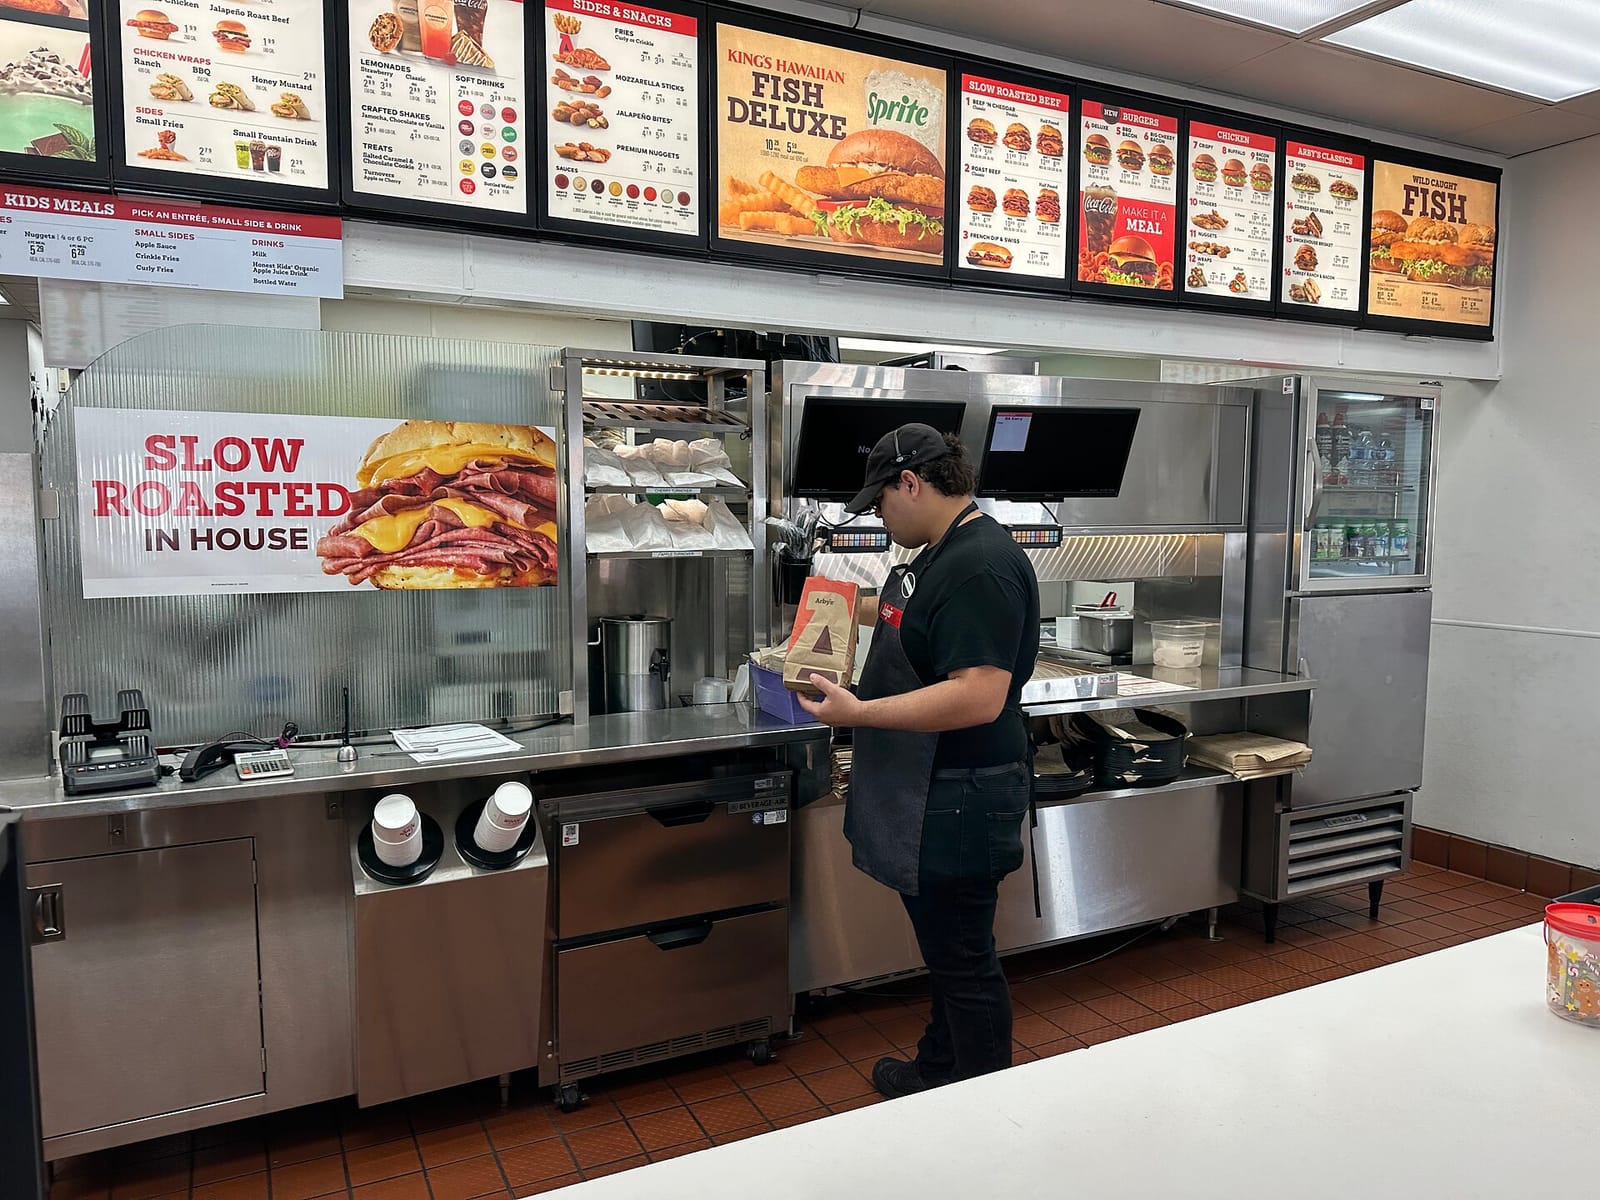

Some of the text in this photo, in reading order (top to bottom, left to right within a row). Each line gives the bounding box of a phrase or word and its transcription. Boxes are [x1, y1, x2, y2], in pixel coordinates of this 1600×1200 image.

[209, 4, 290, 24] Jalapeño Roast Beef
[573, 0, 672, 28] SIDES & SNACKS
[614, 27, 634, 37] FRIES
[133, 48, 211, 66] CHICKEN WRAPS
[134, 57, 161, 68] Ranch
[192, 66, 211, 76] BBQ
[360, 58, 411, 73] LEMONADES
[360, 66, 394, 78] Strawberry
[727, 48, 845, 84] KING'S HAWAIIAN
[252, 76, 277, 88] Honey
[279, 80, 312, 91] Mustard
[405, 74, 426, 82] Classic
[455, 75, 504, 89] SOFT DRINKS
[616, 74, 684, 92] MOZZARELLA STICKS
[752, 71, 824, 109] FISH
[969, 80, 1061, 107] SLOW ROASTED BEEF
[135, 106, 164, 116] SIDES
[868, 91, 929, 126] Sprite
[966, 97, 970, 105] 1
[992, 103, 1015, 112] CHEDDAR
[361, 104, 430, 121] CRAFTED SHAKES
[616, 109, 651, 121] JALAPEÑO
[727, 96, 847, 140] DELUXE
[1104, 108, 1159, 126] NEW BURGERS
[136, 116, 184, 129] Small Fries
[361, 112, 388, 122] Jamocha,
[389, 117, 417, 126] Chocolate
[425, 122, 445, 130] Vanilla
[1085, 121, 1090, 129] 4
[233, 129, 317, 147] Small Fountain Drink
[1144, 132, 1149, 140] 6
[1217, 130, 1250, 144] CHICKEN
[362, 143, 393, 152] TREATS
[616, 144, 679, 160] PREMIUM NUGGETS
[363, 158, 393, 167] Chocolate
[383, 155, 408, 163] Caramel
[1251, 152, 1255, 160] 9
[1298, 147, 1352, 164] ARBY'S CLASSICS
[363, 169, 395, 178] Turnovers
[556, 165, 578, 173] SAUCES
[964, 164, 970, 172] 2
[1412, 175, 1458, 191] WILD CAUGHT
[4, 193, 115, 216] KIDS MEALS
[1402, 184, 1467, 224] FISH
[132, 208, 153, 218] PICK
[156, 211, 170, 220] AN
[171, 212, 210, 224] ENTRÉE,
[212, 217, 242, 227] SMALL
[244, 220, 265, 228] SIDE
[274, 222, 302, 231] DRINK
[1122, 206, 1167, 221] MAKE IT A
[134, 228, 195, 240] SMALL SIDES
[1126, 218, 1162, 235] MEAL
[24, 230, 55, 240] Nuggets
[963, 231, 968, 239] 3
[135, 241, 155, 249] Apple
[252, 239, 284, 248] DRINKS
[136, 264, 158, 273] Curly
[144, 434, 305, 473] SLOW
[857, 445, 871, 453] No
[92, 480, 351, 517] ROASTED
[145, 527, 308, 552] IN HOUSE
